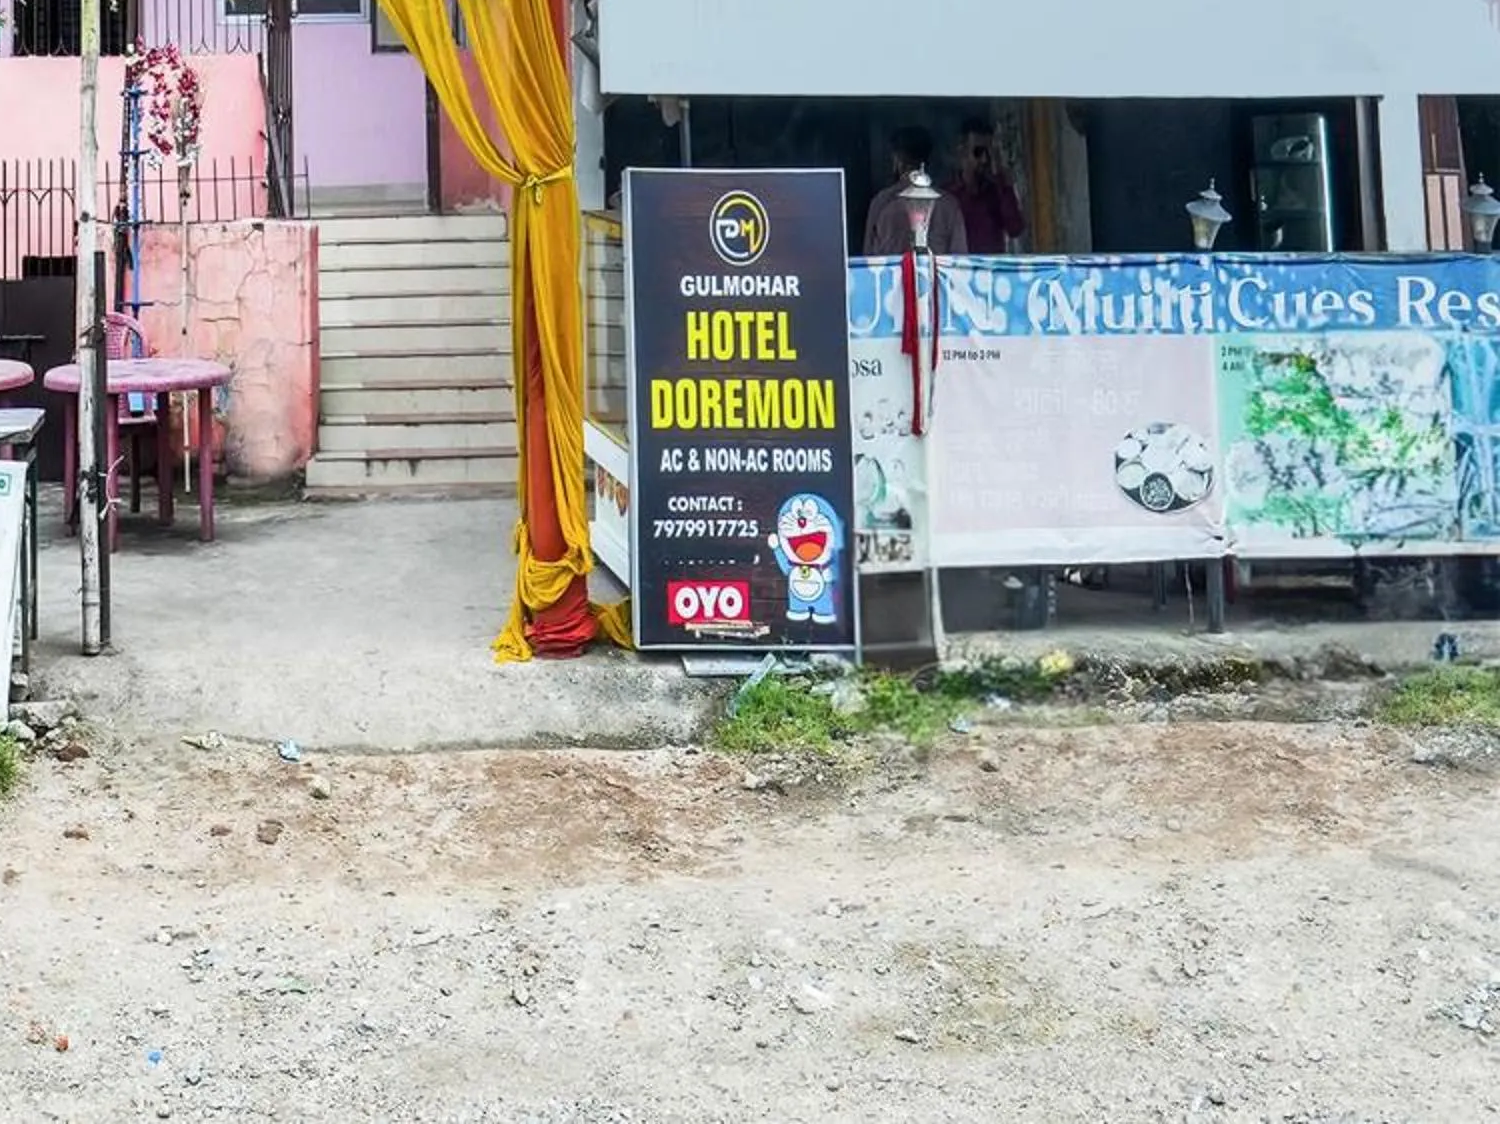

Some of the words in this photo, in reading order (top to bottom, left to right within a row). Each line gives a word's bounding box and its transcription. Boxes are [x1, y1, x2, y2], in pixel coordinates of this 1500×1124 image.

[679, 275, 801, 297] GULMOHAR
[686, 310, 797, 361] HOTEL
[651, 378, 836, 430] DOREMON
[660, 448, 683, 472] AC
[688, 449, 701, 472] &
[705, 448, 768, 473] NON-AC
[772, 448, 832, 473] ROOMS
[653, 519, 759, 538] 7979917725
[675, 585, 744, 620] OYO
